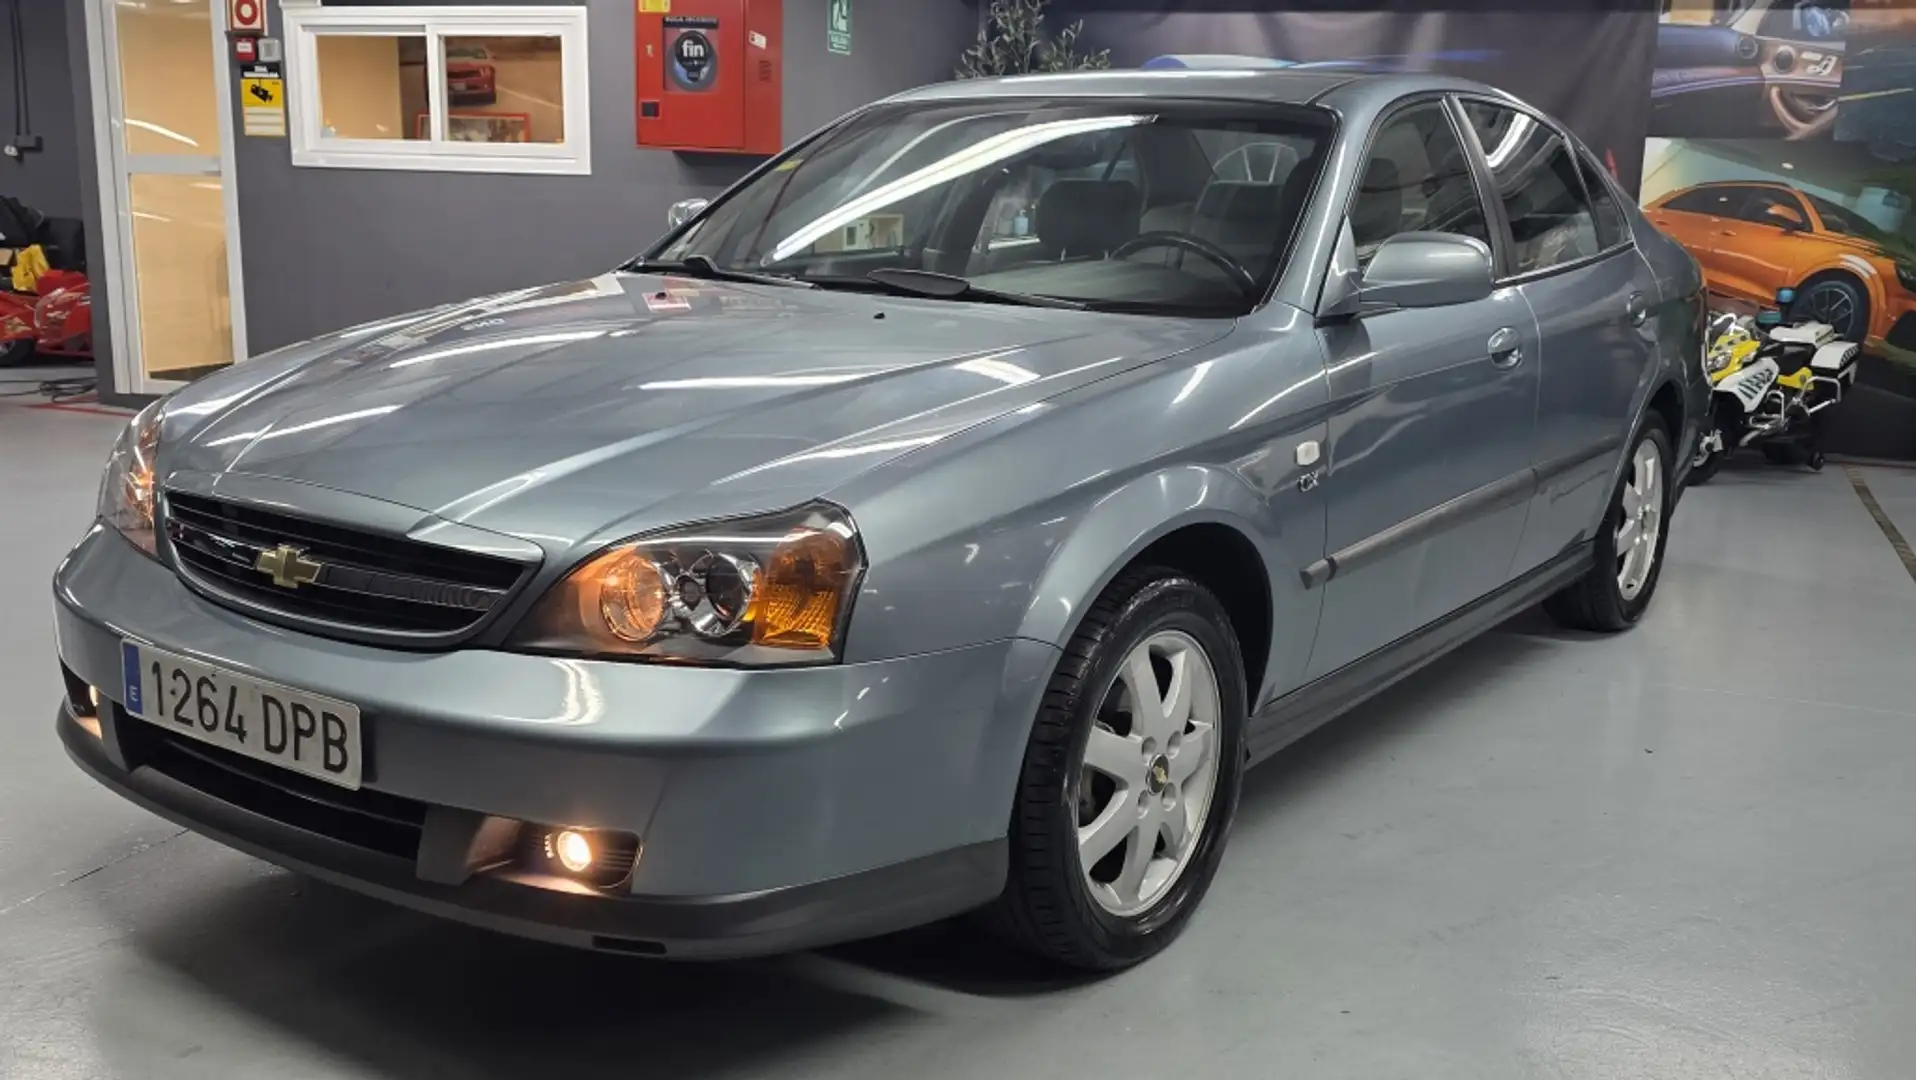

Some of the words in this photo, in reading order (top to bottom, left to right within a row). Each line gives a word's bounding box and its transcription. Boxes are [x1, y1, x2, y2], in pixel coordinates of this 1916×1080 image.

[681, 39, 705, 57] fin
[129, 685, 138, 702] E
[152, 661, 247, 743] 1264
[262, 694, 348, 774] DPB
